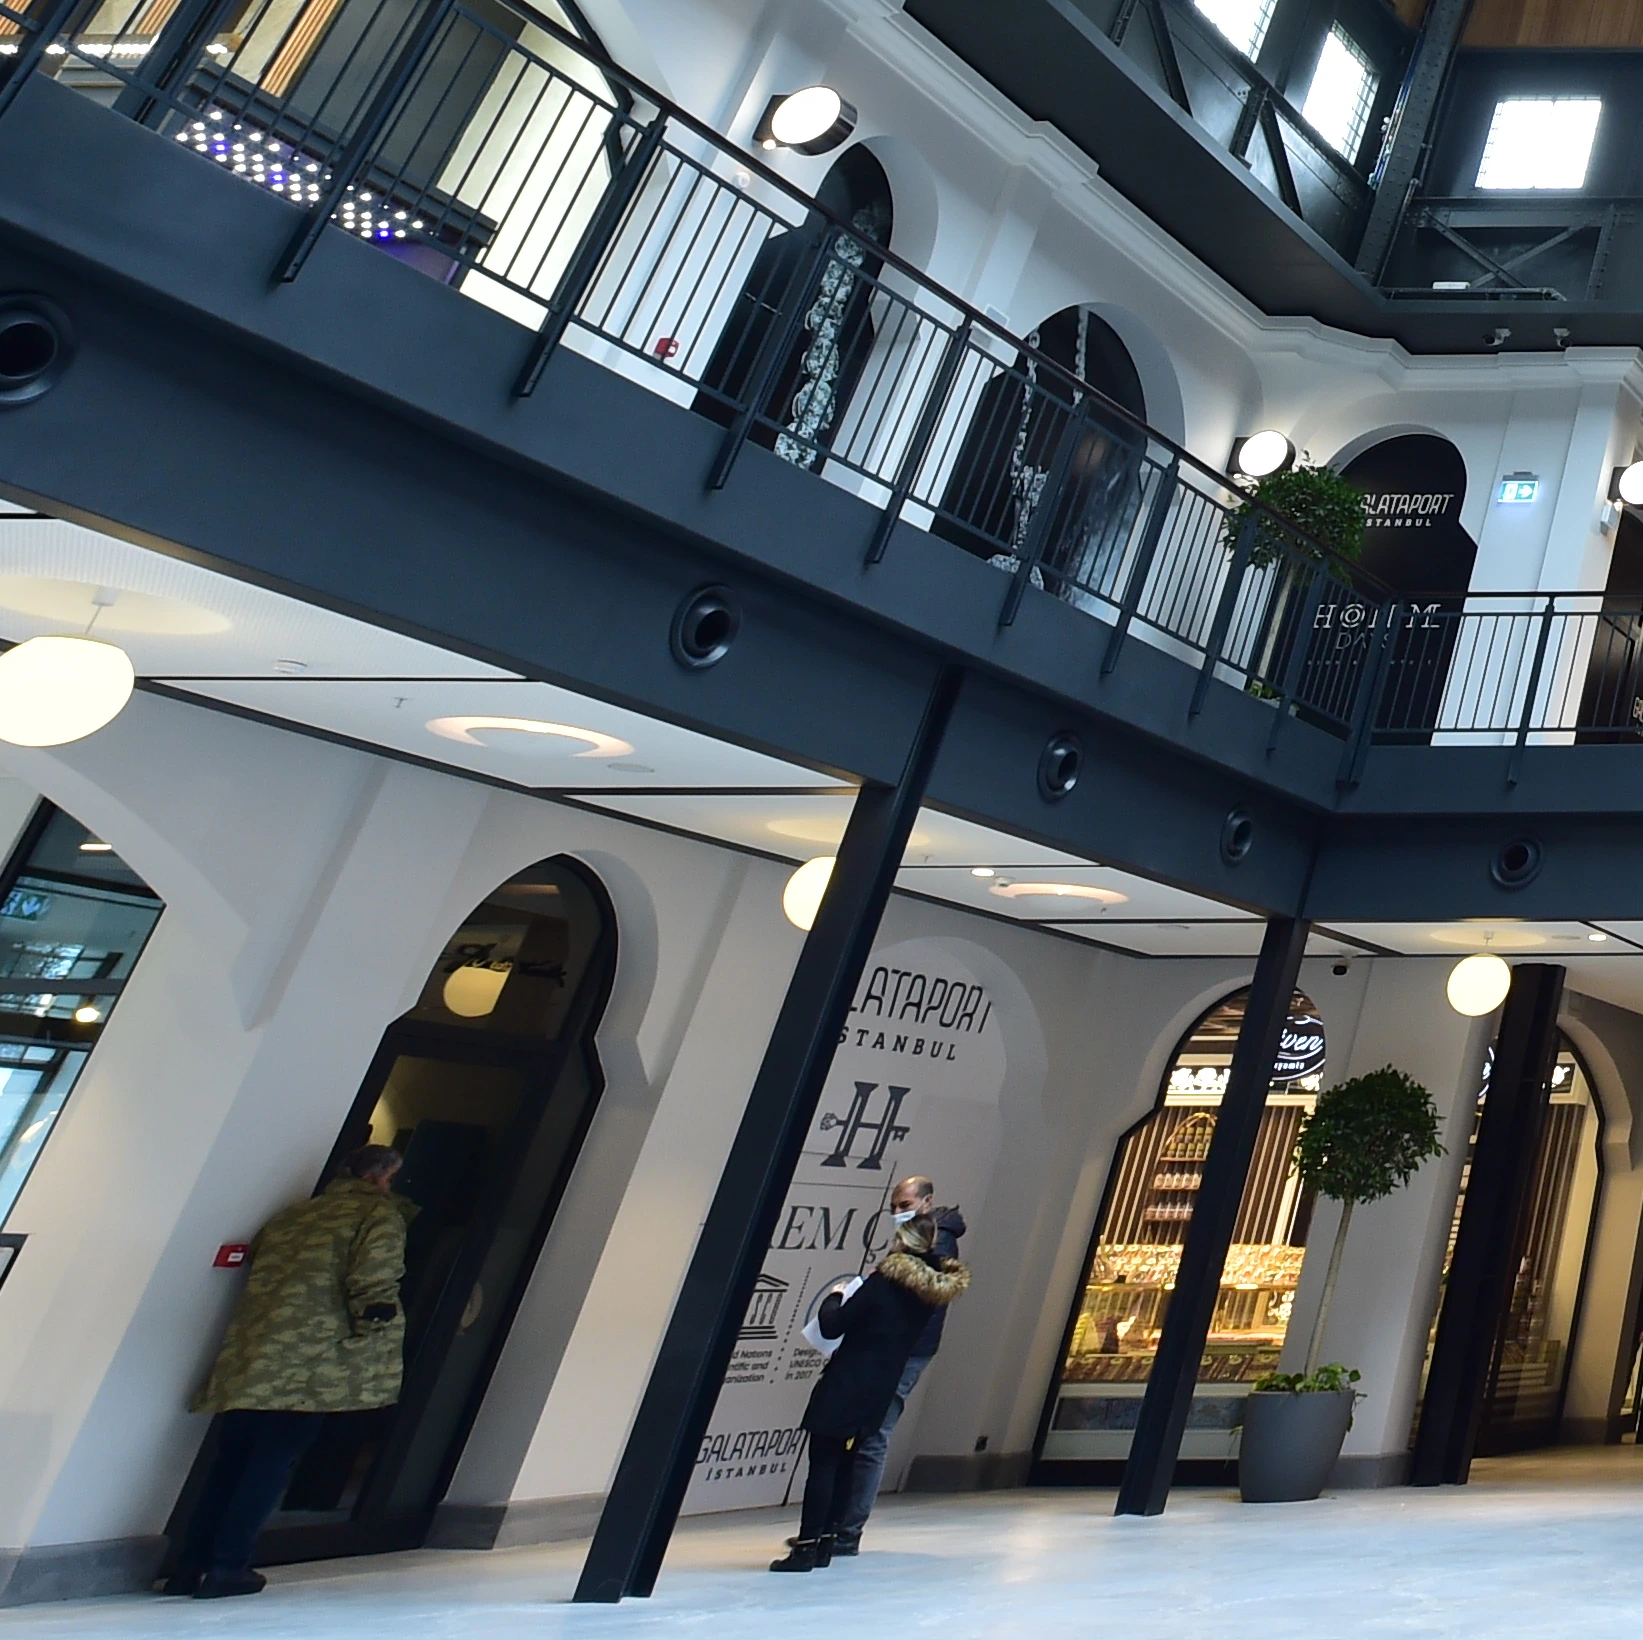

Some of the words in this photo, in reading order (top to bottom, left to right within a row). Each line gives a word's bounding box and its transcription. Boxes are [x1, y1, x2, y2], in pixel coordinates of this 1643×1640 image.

[1360, 494, 1454, 514] ALATAPORT
[1366, 518, 1432, 527] STANBUL
[850, 967, 991, 1033] ATAPORT
[838, 1027, 956, 1060] STANBUL
[696, 1427, 804, 1464] GALATAPOR
